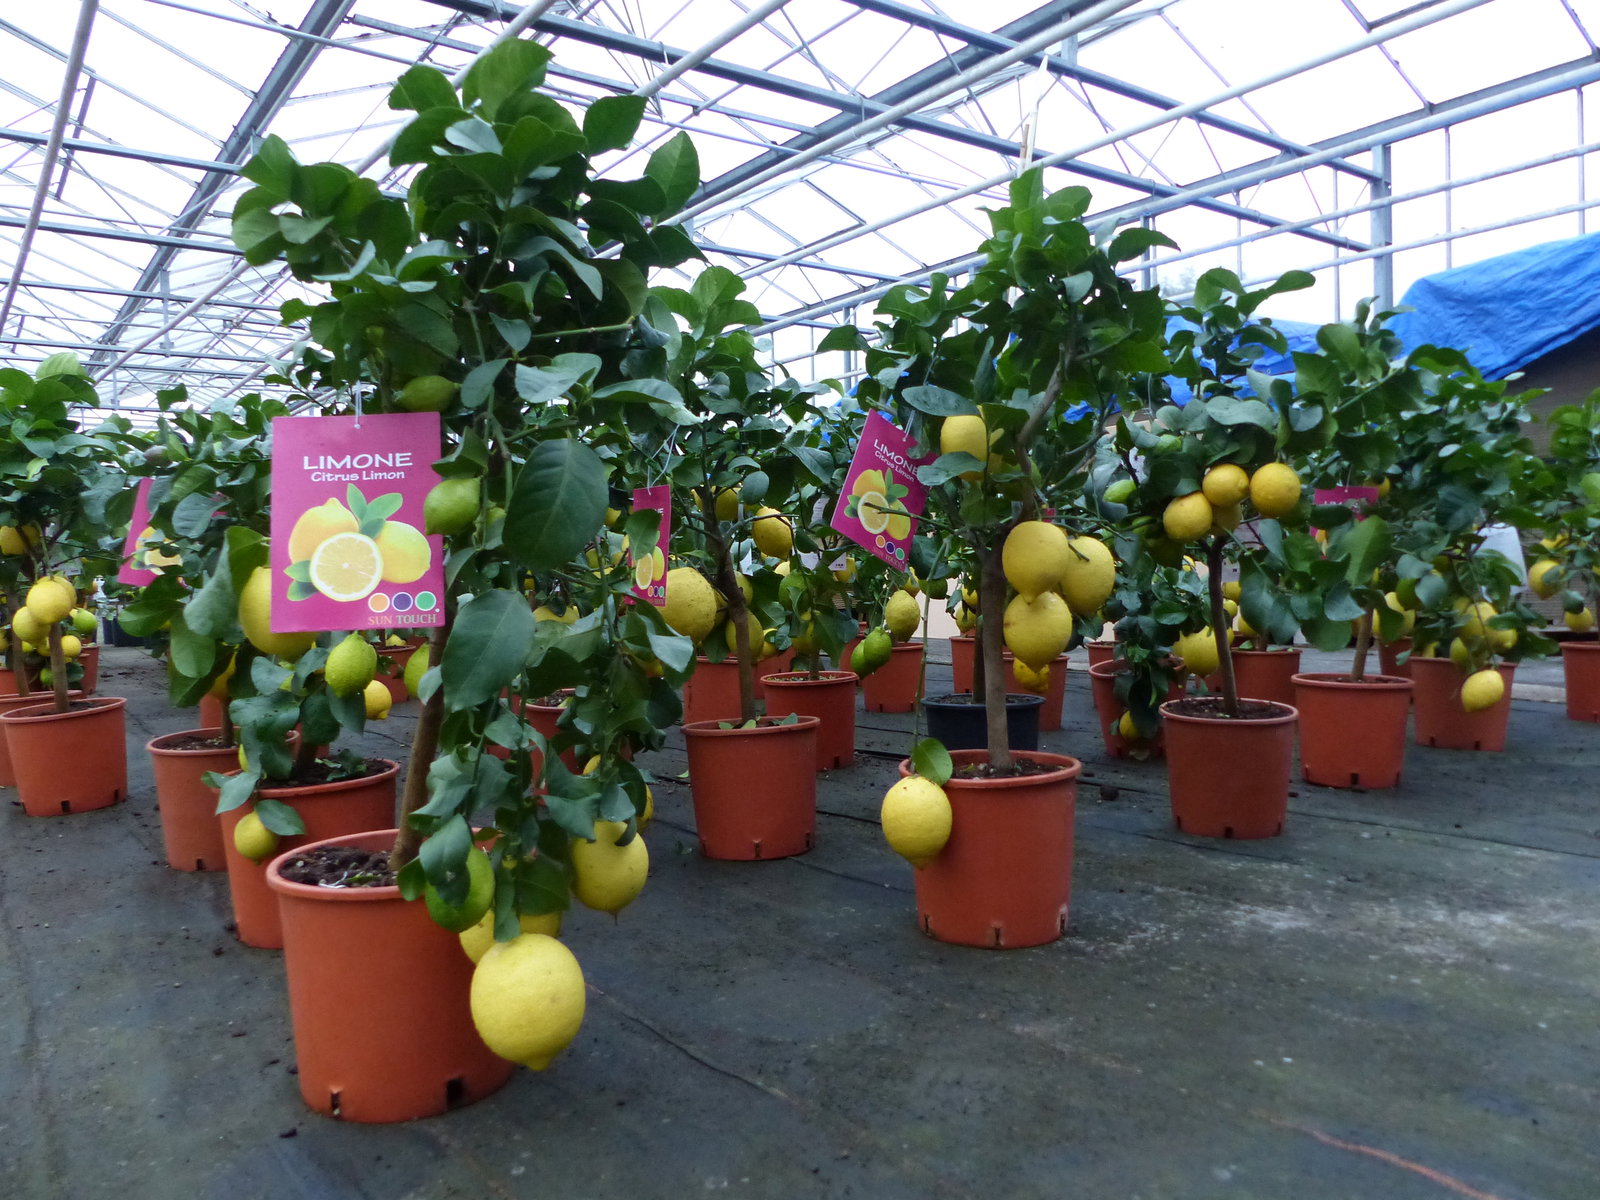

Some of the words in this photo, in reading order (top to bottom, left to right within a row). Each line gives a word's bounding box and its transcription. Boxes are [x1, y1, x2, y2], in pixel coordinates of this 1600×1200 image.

[303, 452, 414, 470] LIMONE
[874, 439, 918, 476] LIMONE
[874, 450, 895, 469] Citrus
[895, 465, 915, 483] Limon
[310, 471, 359, 482] Citrus
[362, 470, 405, 481] Limon
[368, 616, 393, 626] SUN
[396, 614, 437, 625] TOUCH
